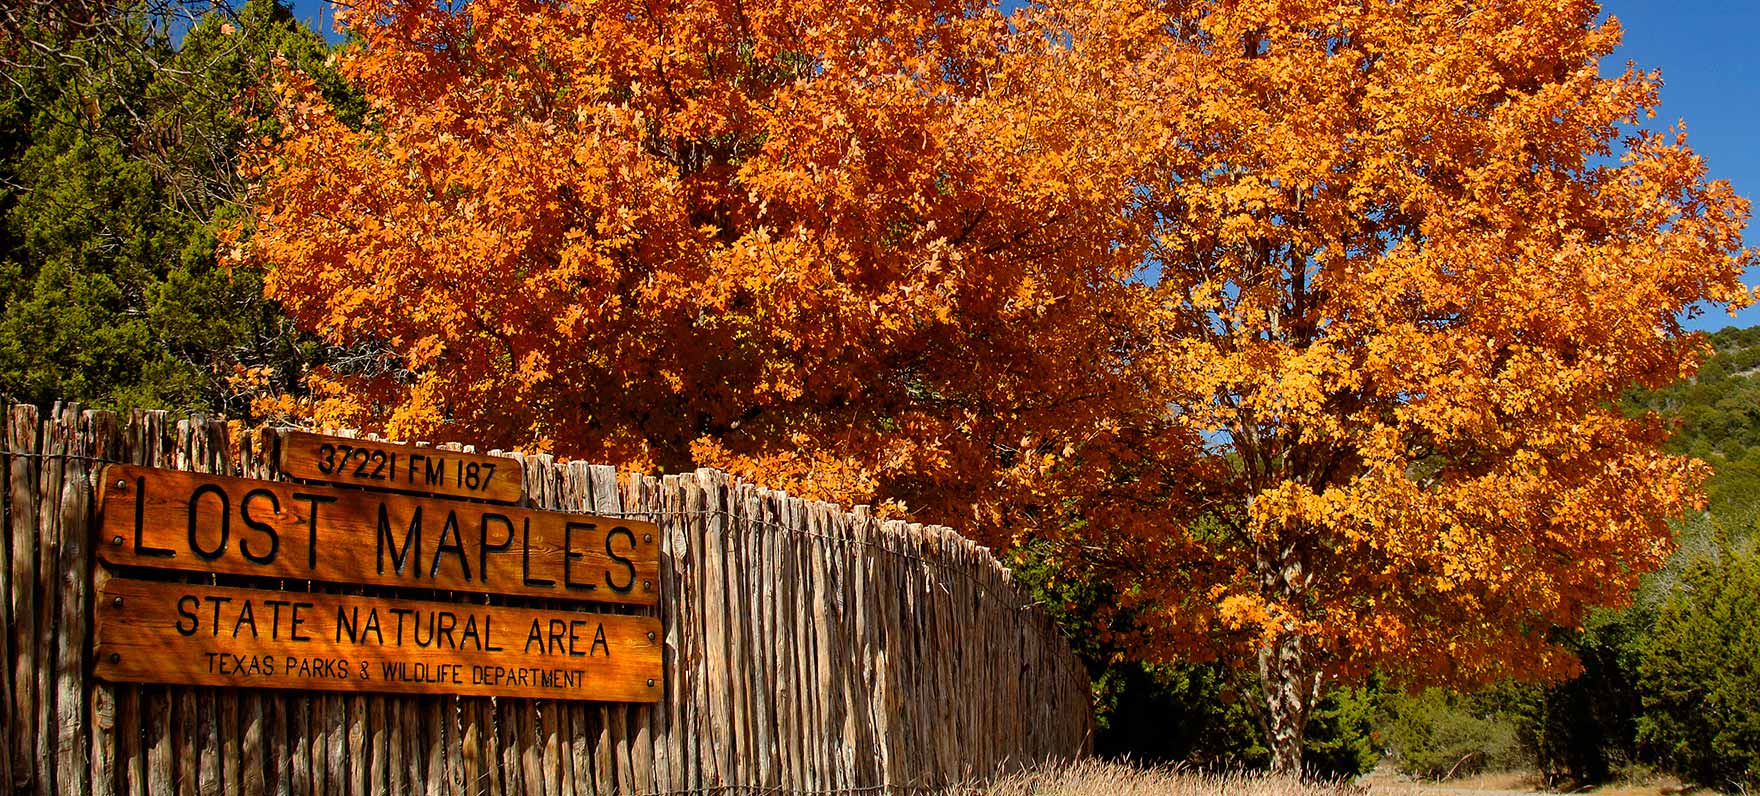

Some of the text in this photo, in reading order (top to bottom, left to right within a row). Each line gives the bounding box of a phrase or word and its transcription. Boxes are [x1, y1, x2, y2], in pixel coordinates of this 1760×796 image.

[318, 443, 497, 492] 37221 FM 187
[134, 475, 637, 594] LOST MAPLES
[176, 595, 610, 657] STATE NATURAL AREA
[204, 652, 586, 689] TEXAS PARKS & WILDLIFE DEPARTMENT
